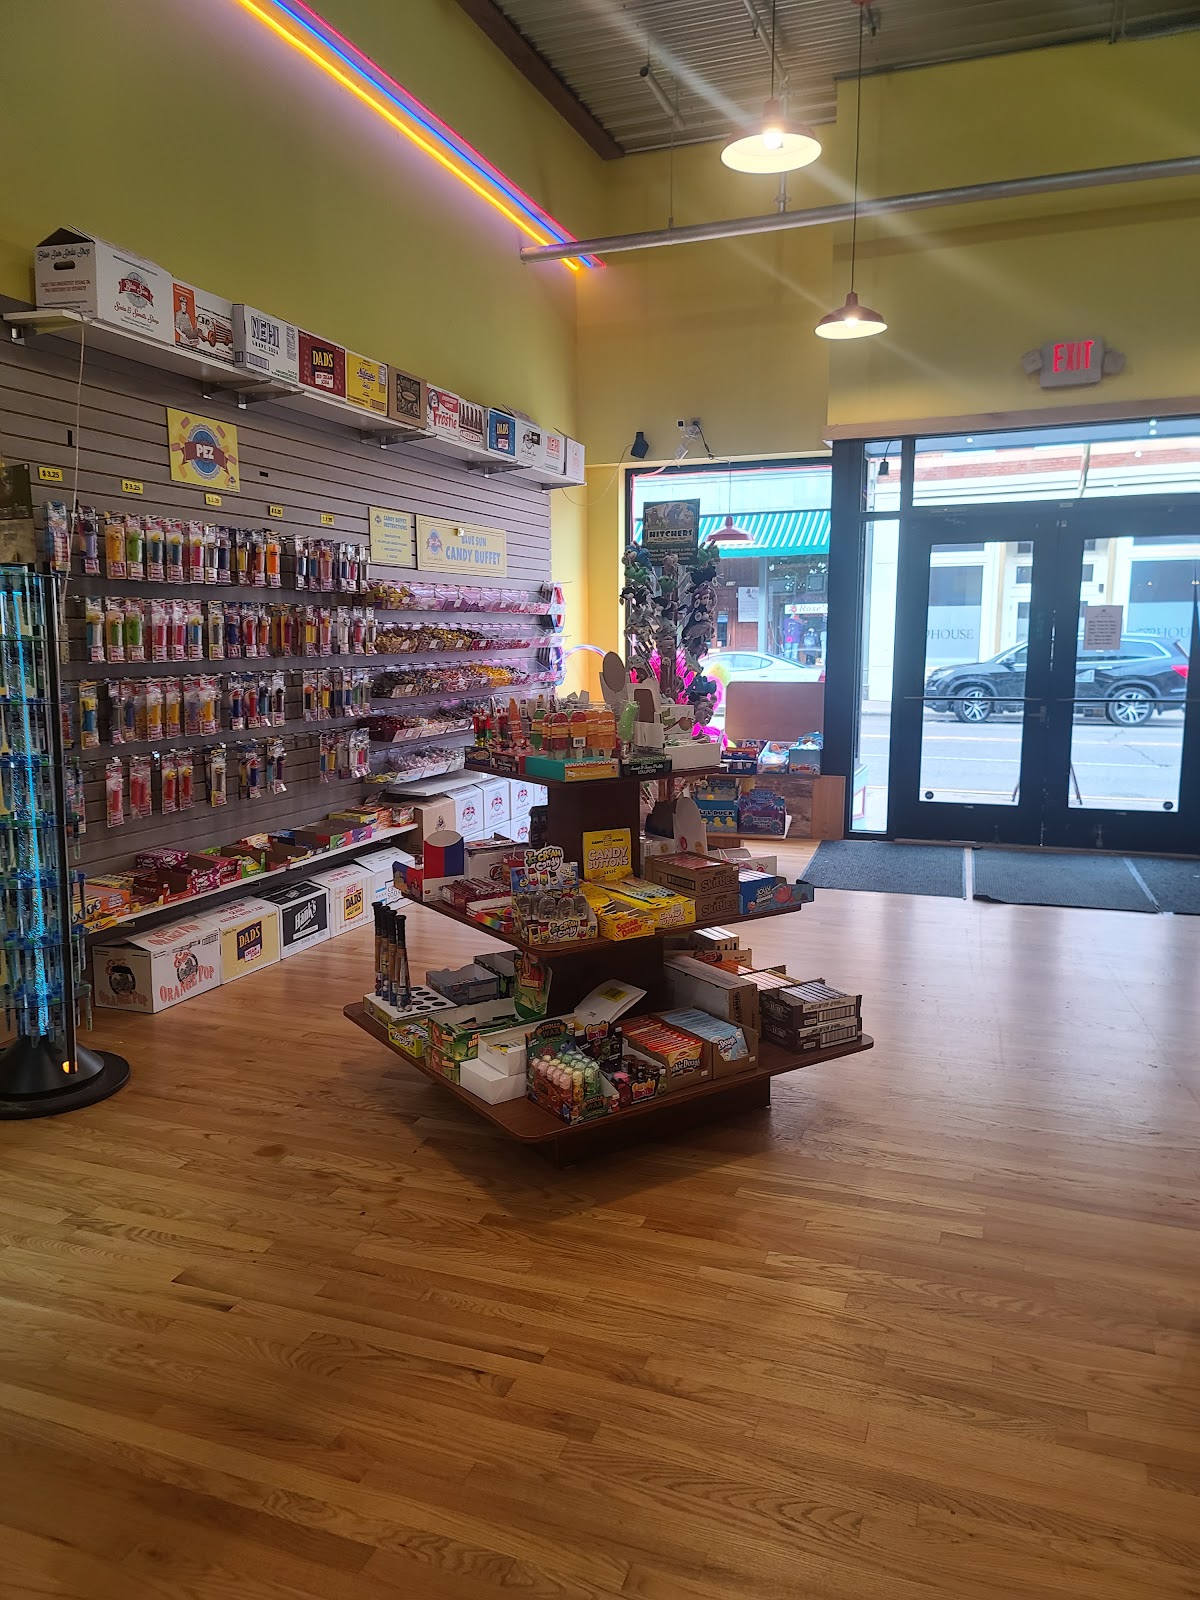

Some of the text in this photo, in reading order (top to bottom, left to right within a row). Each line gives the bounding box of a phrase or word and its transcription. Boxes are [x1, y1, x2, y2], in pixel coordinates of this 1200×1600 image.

[251, 315, 280, 349] NEHI
[312, 350, 334, 368] DAD'S
[1053, 340, 1094, 372] EXIT
[433, 409, 458, 429] Frostie
[195, 443, 215, 460] PEZ
[461, 535, 487, 547] BLUE SUN
[649, 530, 693, 538] HITCHERS
[445, 546, 501, 566] CANDY BUFFET
[588, 846, 628, 860] CANDY
[587, 857, 629, 870] BUTTONS
[701, 874, 736, 892] Skittles
[294, 899, 317, 931] Hank's
[701, 898, 736, 917] Skittles
[616, 919, 639, 932] SUGAR
[621, 924, 643, 938] DADDY
[239, 926, 261, 948] DAD'S
[197, 964, 214, 984] POP
[719, 1036, 737, 1048] Dough
[683, 1058, 701, 1068] Dough
